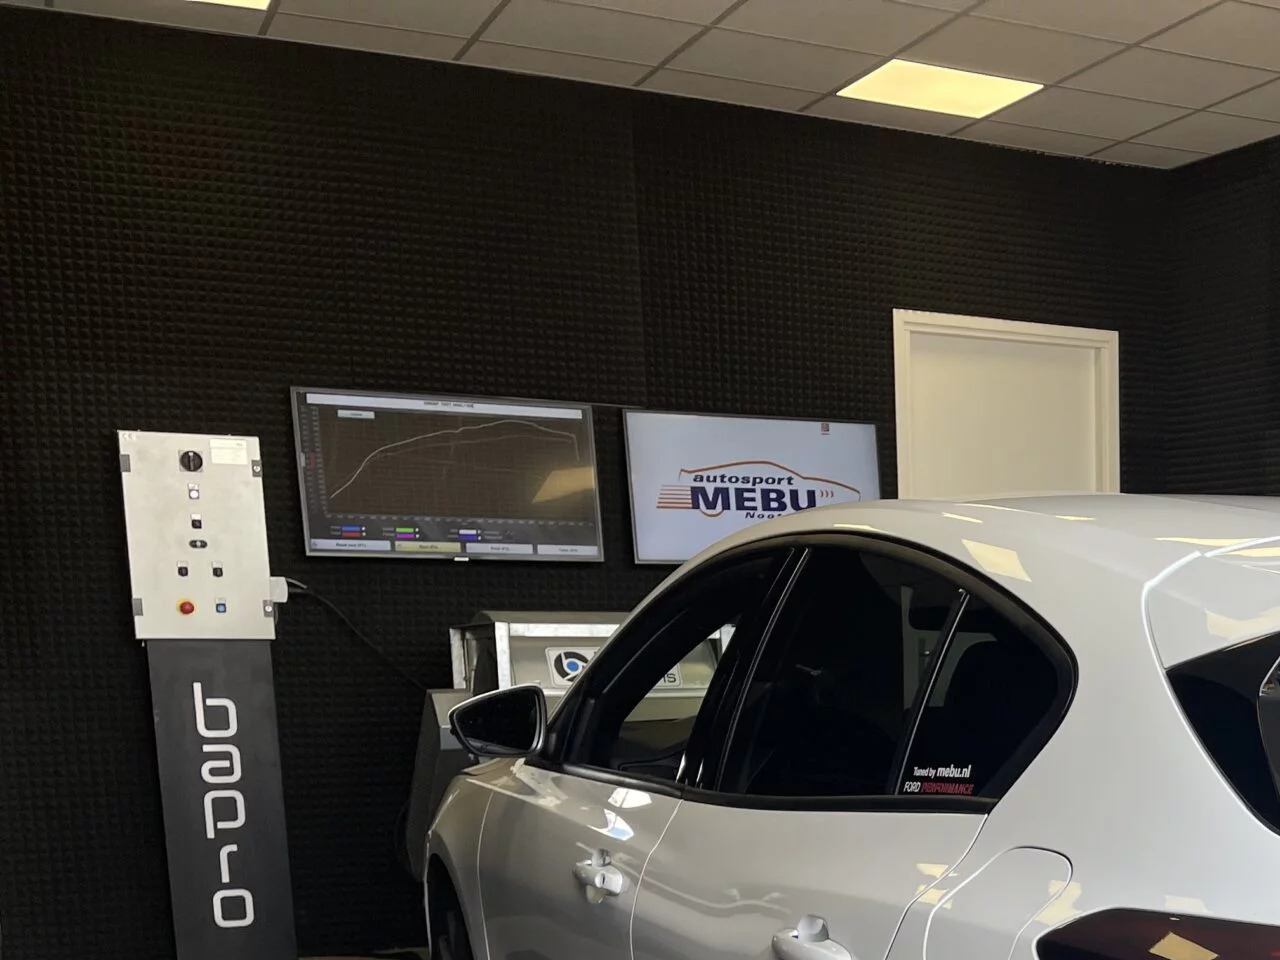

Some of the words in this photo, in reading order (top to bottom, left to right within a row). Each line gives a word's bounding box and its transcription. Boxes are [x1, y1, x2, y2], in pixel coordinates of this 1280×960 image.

[692, 473, 795, 487] autosport
[690, 486, 817, 512] MEBU
[745, 511, 782, 520] Noo
[913, 766, 929, 777] Tuned
[929, 767, 936, 779] by
[937, 764, 972, 778] mebu.nl
[903, 781, 921, 793] FORD
[921, 782, 974, 795] PERFORMANCE
[193, 682, 255, 928] bapro
